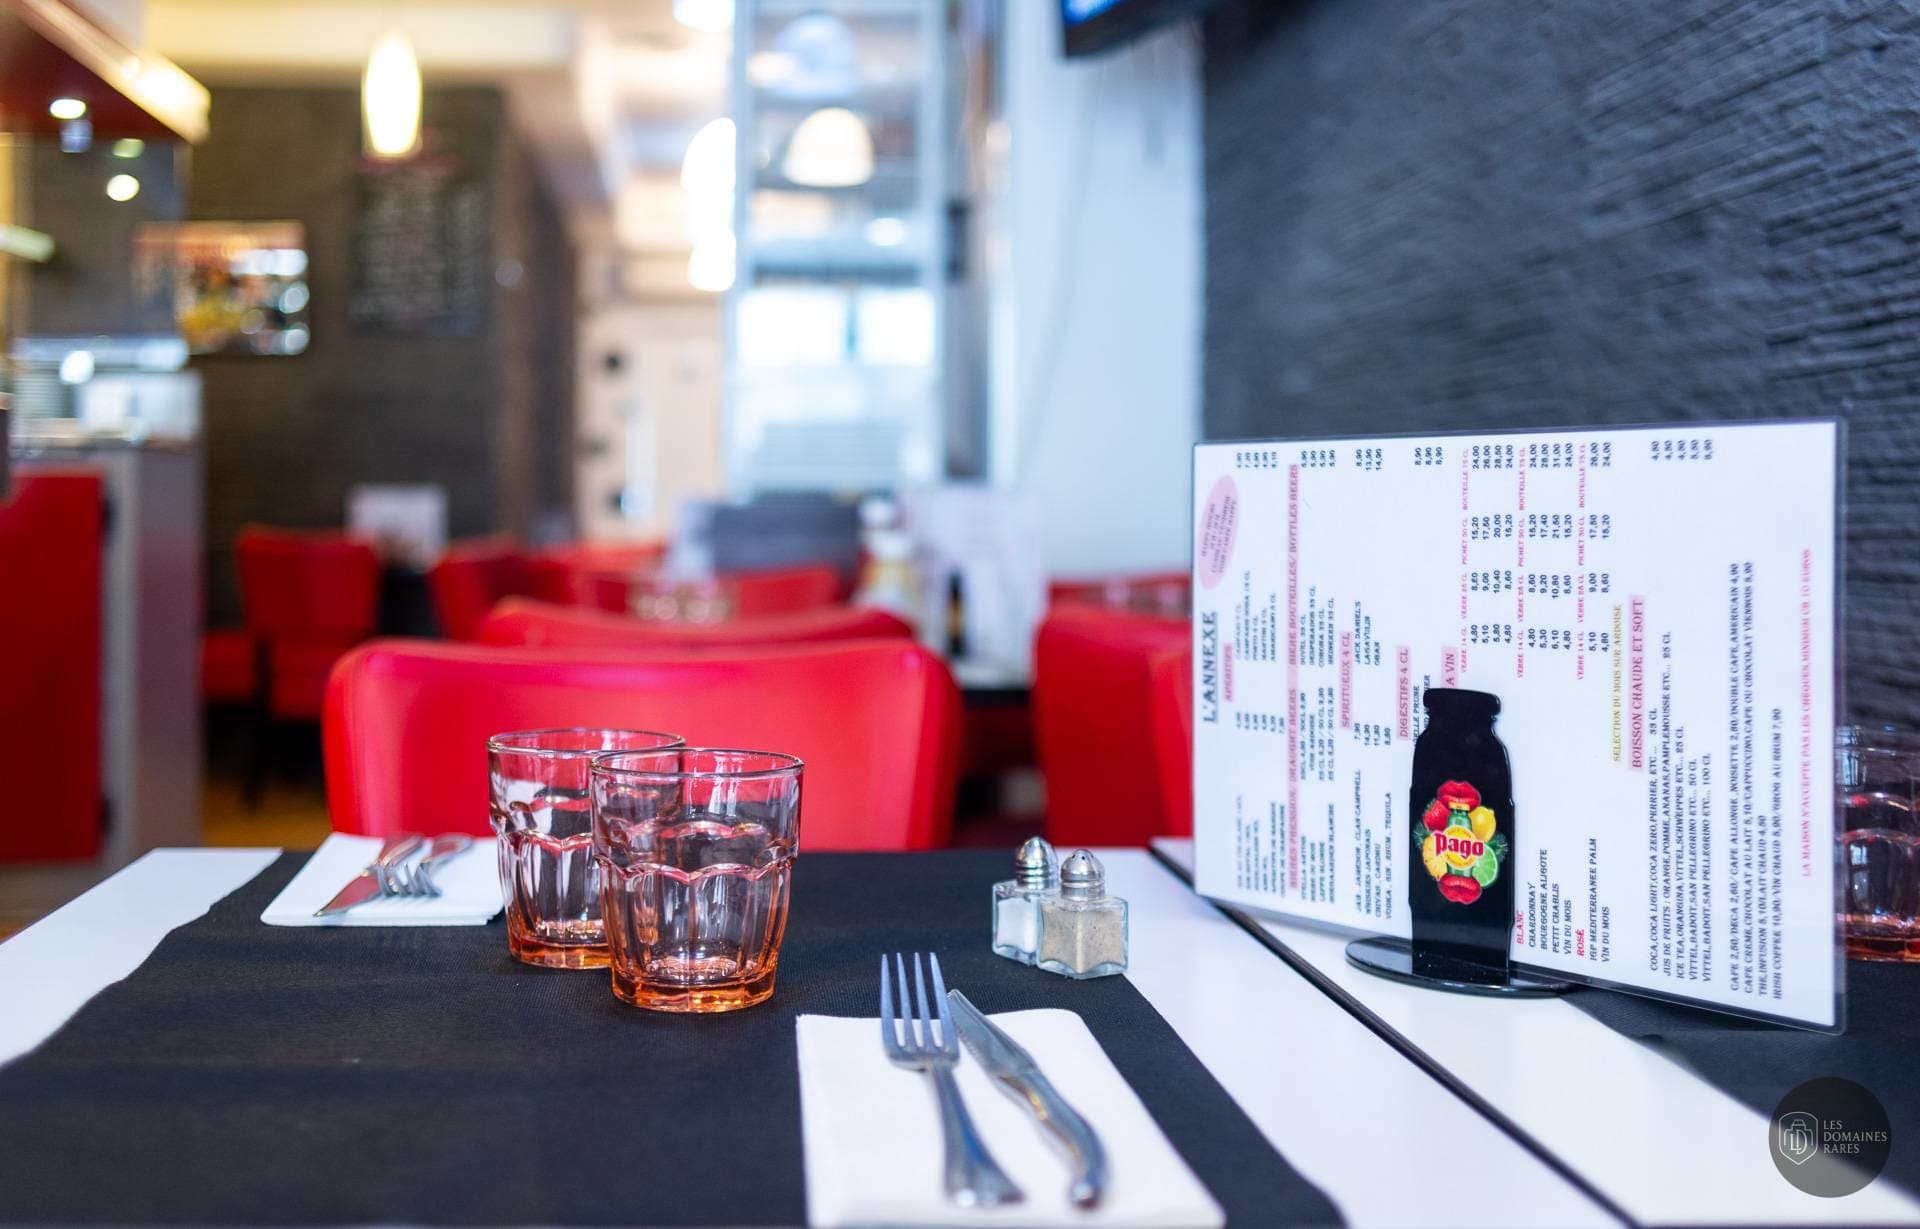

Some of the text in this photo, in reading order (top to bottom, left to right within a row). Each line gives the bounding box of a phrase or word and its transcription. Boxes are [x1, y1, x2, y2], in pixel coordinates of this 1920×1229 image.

[1552, 514, 1560, 539] 21,50
[1564, 514, 1572, 538] 15,20
[1602, 514, 1610, 539] 15,20
[1601, 573, 1609, 593] 8,60
[1601, 633, 1609, 652] 4,80
[1662, 632, 1670, 644] CL
[1203, 612, 1217, 722] L'ANNEXE
[1399, 649, 1408, 664] CL
[1445, 653, 1454, 673] VIN
[1613, 650, 1621, 668] SUR
[1744, 634, 1752, 687] CHOCOLAT
[1613, 670, 1621, 692] MOIS
[1632, 600, 1642, 768] BOISSON CHAUDE ET SOFT
[1613, 696, 1621, 708] DU
[1744, 690, 1752, 703] OU
[1399, 678, 1408, 737] DIGESTIFS
[1649, 708, 1657, 721] CL
[1676, 726, 1683, 739] CL
[1802, 714, 1811, 733] LES
[1613, 710, 1621, 762] SELECTION
[1802, 736, 1810, 757] PAS
[1689, 759, 1697, 771] CL
[1773, 763, 1781, 778] AU
[1702, 753, 1711, 881] PELLEGRINO 100 CL
[1435, 833, 1484, 859] pago
[1689, 819, 1697, 880] PELLEGRINO
[1744, 828, 1752, 851] LAIT
[1802, 820, 1810, 860] MAISON
[1744, 855, 1752, 869] AU
[1758, 839, 1766, 874] CHAUD
[1773, 840, 1781, 876] CHAUD
[1803, 863, 1811, 877] LA
[1730, 799, 1739, 991] CAFE CAFE ALLONGE
[1564, 925, 1571, 937] DU
[1663, 906, 1671, 940] FRUITS
[1576, 929, 1584, 956] ROSÉ
[1602, 932, 1609, 945] DU
[1601, 947, 1609, 962] VIN
[1663, 943, 1671, 956] DE
[1663, 958, 1671, 976] JUS
[1676, 963, 1684, 979] ICE
[1744, 966, 1753, 994] CAFE
[1773, 972, 1782, 1000] IRISH
